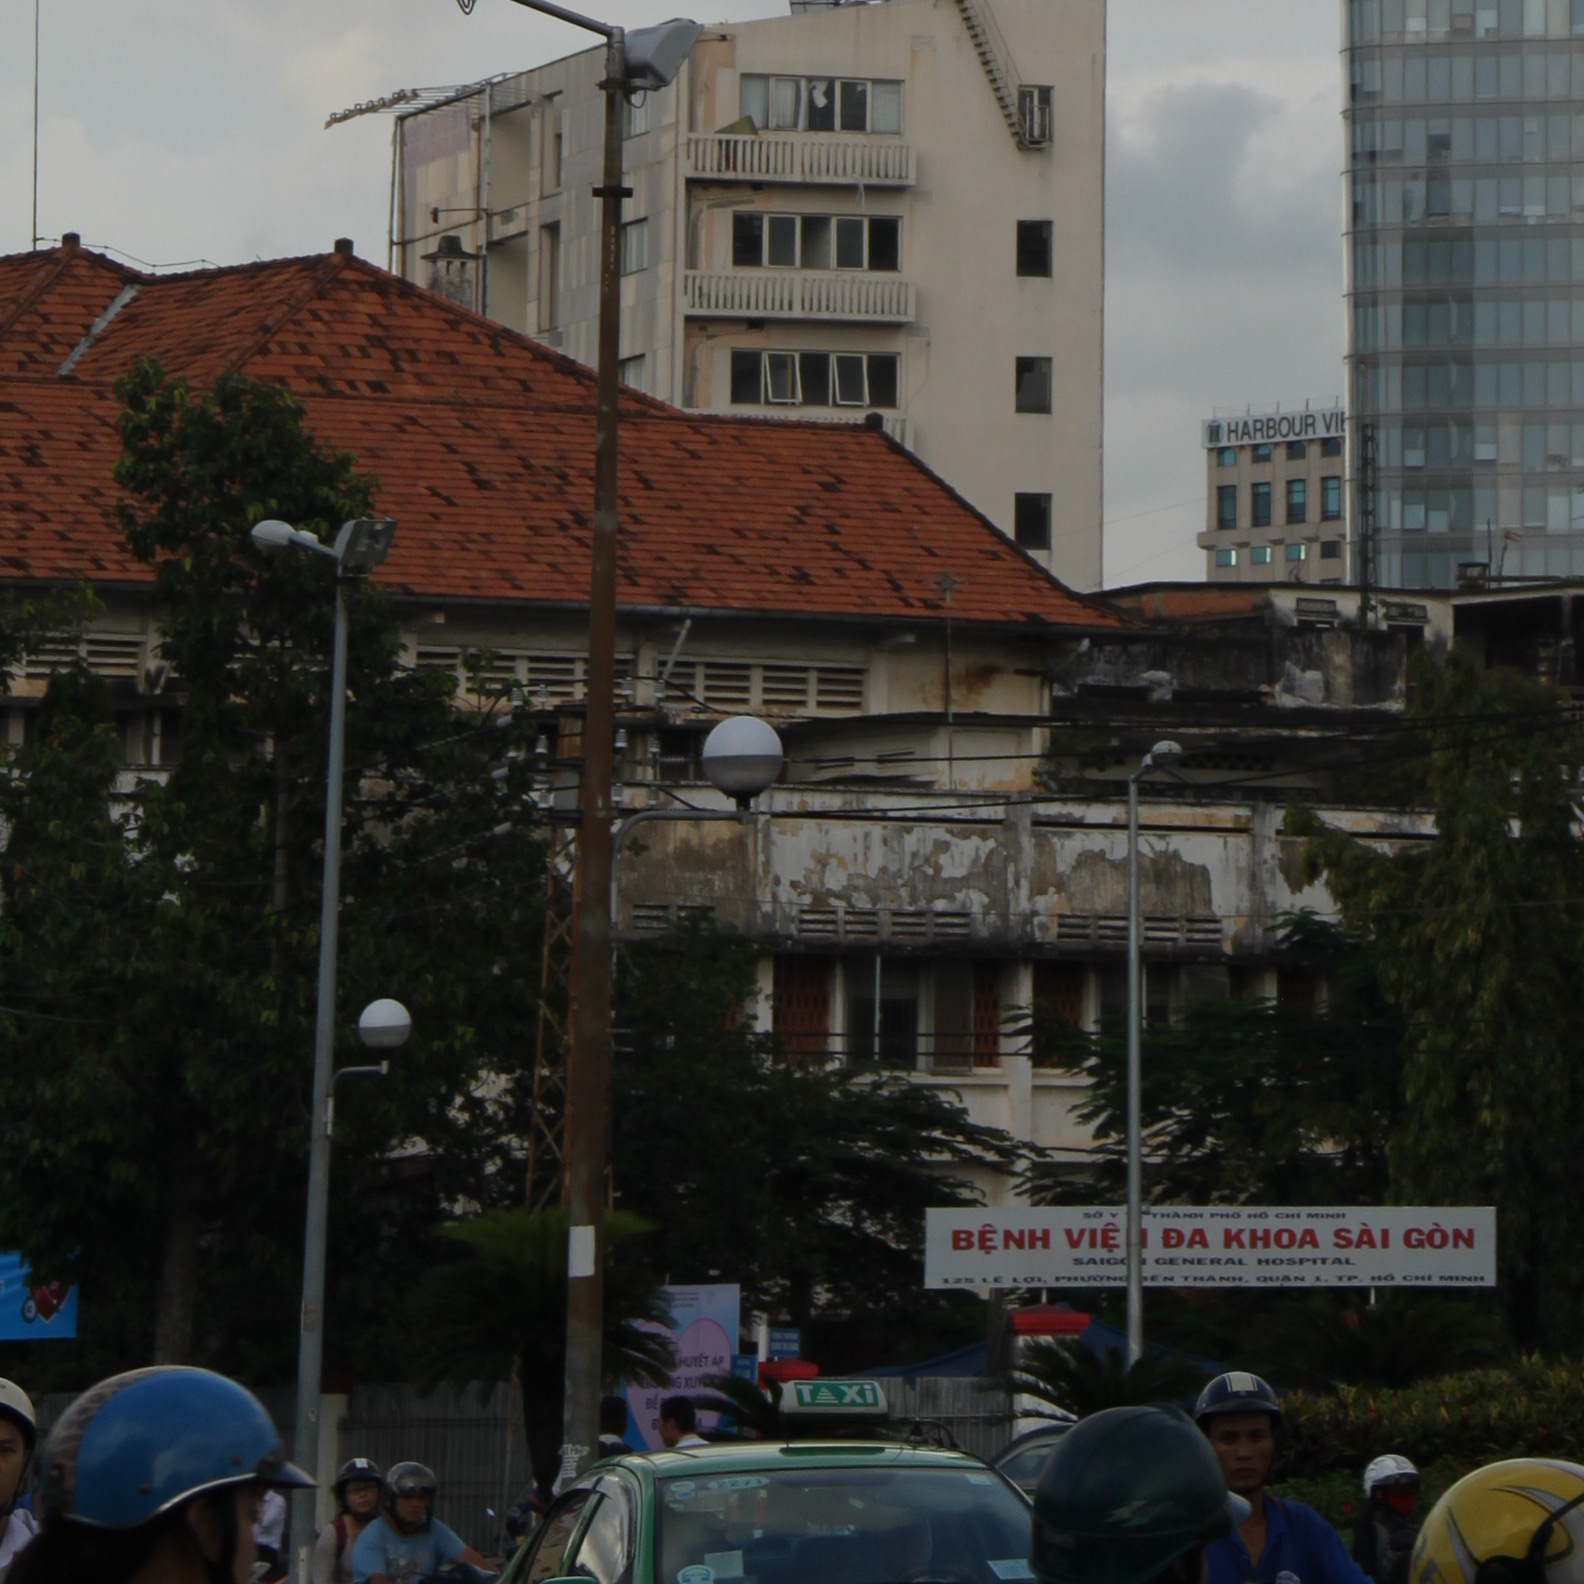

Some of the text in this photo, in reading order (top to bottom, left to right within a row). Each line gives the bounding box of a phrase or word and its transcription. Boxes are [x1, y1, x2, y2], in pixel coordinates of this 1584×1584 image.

[1226, 414, 1316, 443] HARBOUR
[1275, 1211, 1301, 1219] CHÍ
[952, 1223, 1050, 1254] BỆNH
[1161, 1226, 1209, 1249] ĐA
[1223, 1226, 1320, 1249] KHOA
[1332, 1222, 1390, 1249] SÀI
[1403, 1222, 1475, 1249] GÒN
[1155, 1257, 1249, 1266] GENERAL
[1257, 1257, 1356, 1266] HOSPITAL
[943, 1276, 975, 1284] 125
[1402, 1274, 1432, 1282] CHÍ
[1438, 1274, 1486, 1282] MINH
[712, 1353, 725, 1367] ÁP
